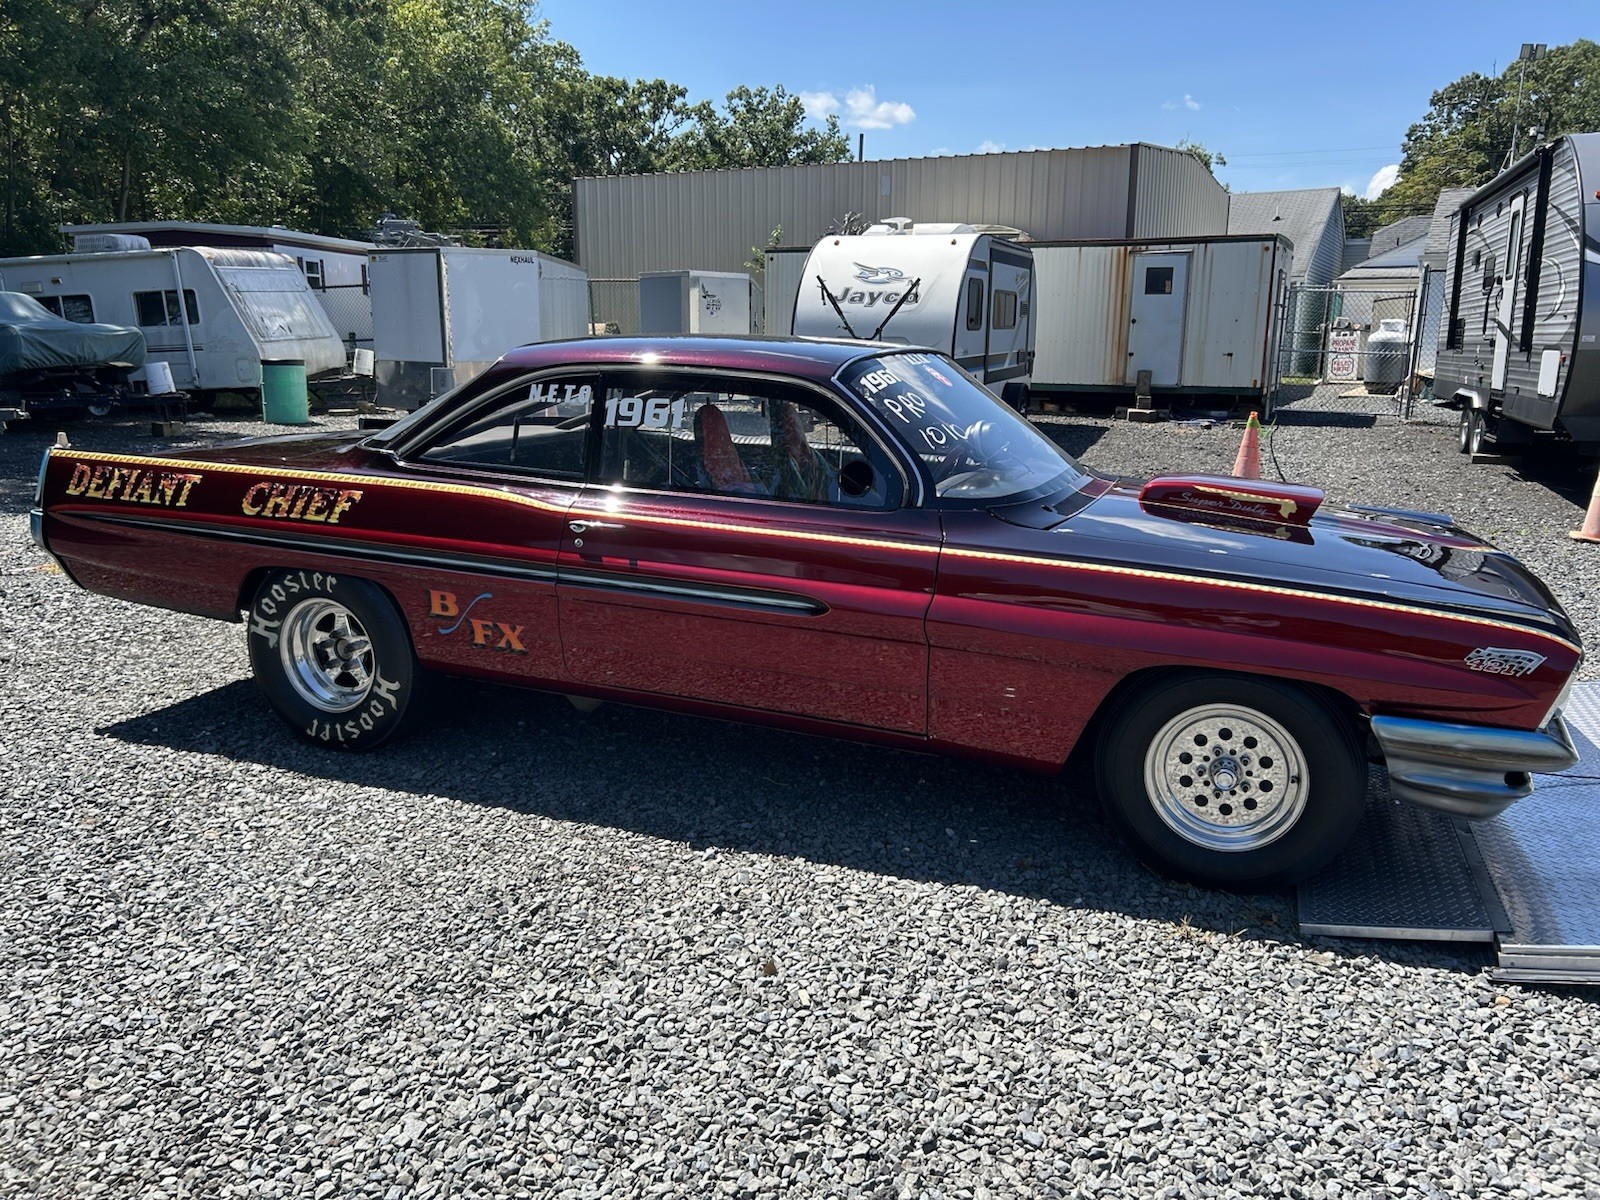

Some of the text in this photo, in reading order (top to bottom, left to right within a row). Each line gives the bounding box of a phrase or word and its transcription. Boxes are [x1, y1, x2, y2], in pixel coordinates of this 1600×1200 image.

[510, 256, 534, 264] NEXHAUL
[833, 286, 921, 308] Jayco
[1332, 339, 1357, 347] PROPANE
[860, 369, 902, 394] 1961
[605, 397, 686, 428] 1961
[883, 392, 926, 424] PRO
[65, 462, 364, 524] DEFIANT CHIEF
[1180, 491, 1277, 517] Super Duty
[250, 571, 338, 649] Hoosier
[1466, 657, 1516, 676] 421
[306, 664, 402, 747] Hoosier
